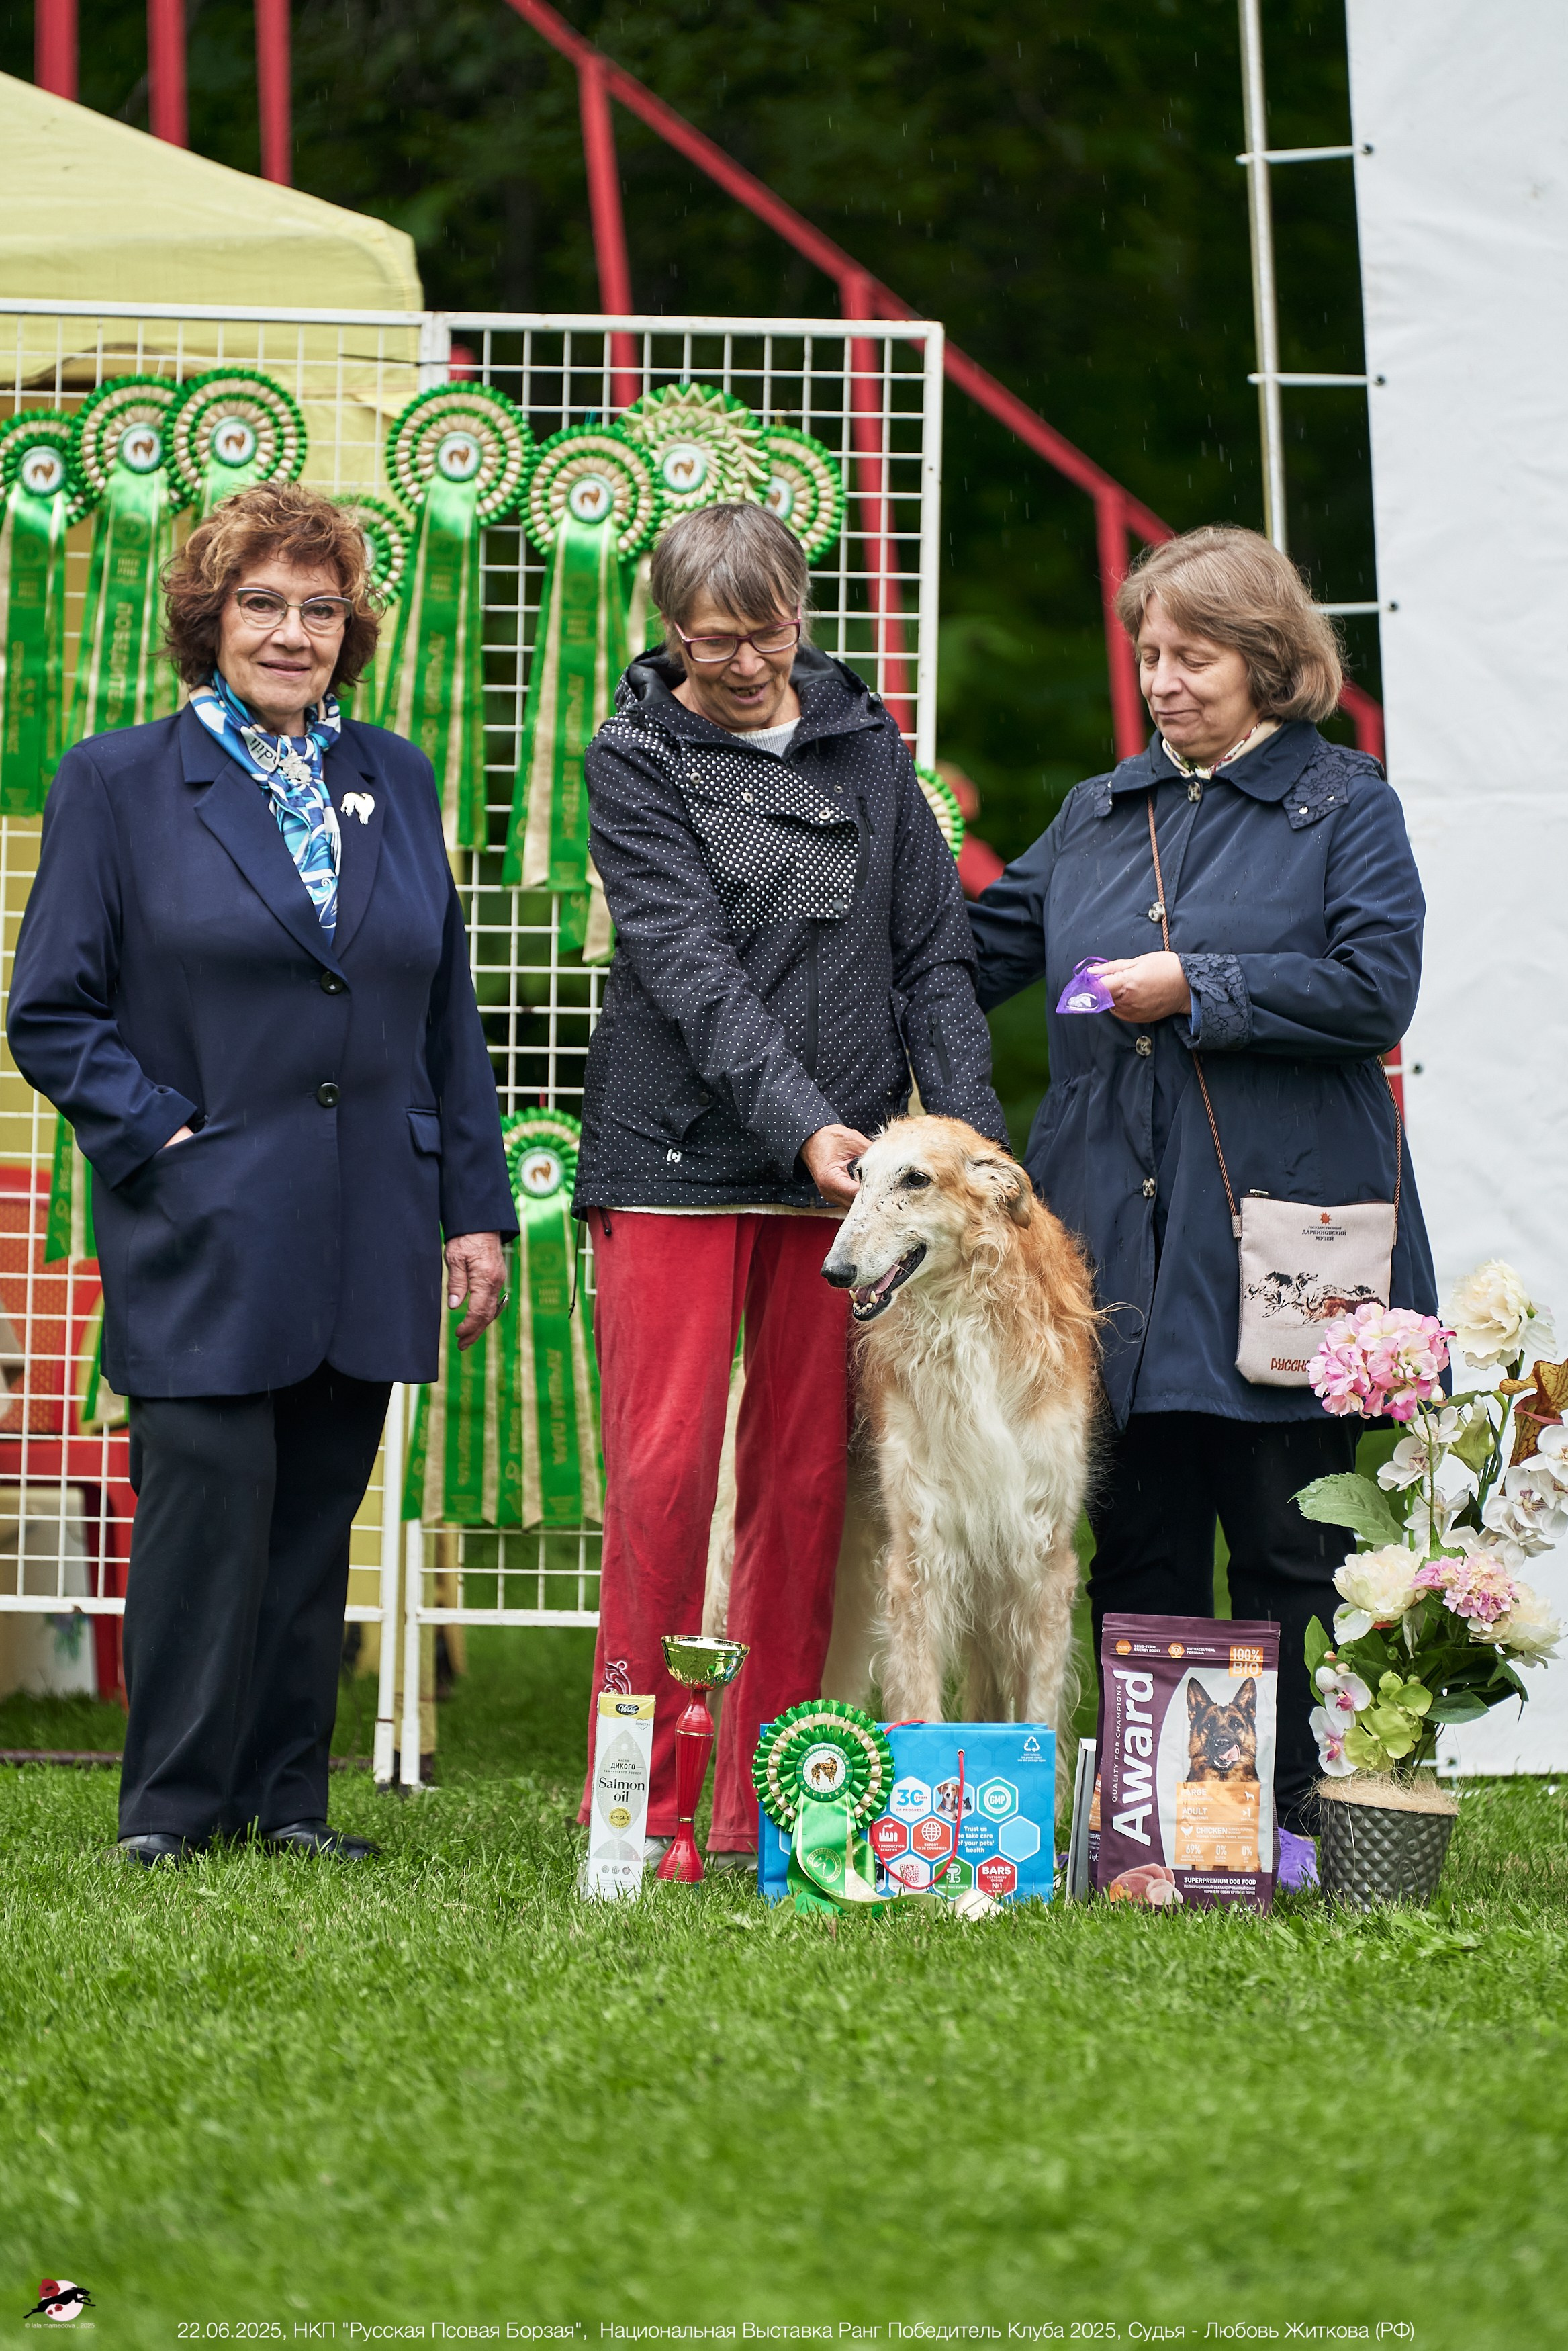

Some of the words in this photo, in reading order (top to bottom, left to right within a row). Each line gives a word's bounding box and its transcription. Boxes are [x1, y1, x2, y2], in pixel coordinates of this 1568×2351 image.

[1232, 1648, 1260, 1661] 100%
[1232, 1662, 1260, 1675] BIO
[1113, 1670, 1154, 1847] Award
[598, 1777, 645, 1791] Salmon
[614, 1791, 629, 1802] oil
[989, 1795, 1006, 1805] GMP
[1182, 1807, 1207, 1815] ADULT
[1186, 1844, 1201, 1854] 69%
[1216, 1845, 1227, 1855] 0%
[1242, 1845, 1253, 1856] 0%
[982, 1866, 1011, 1875] BARS
